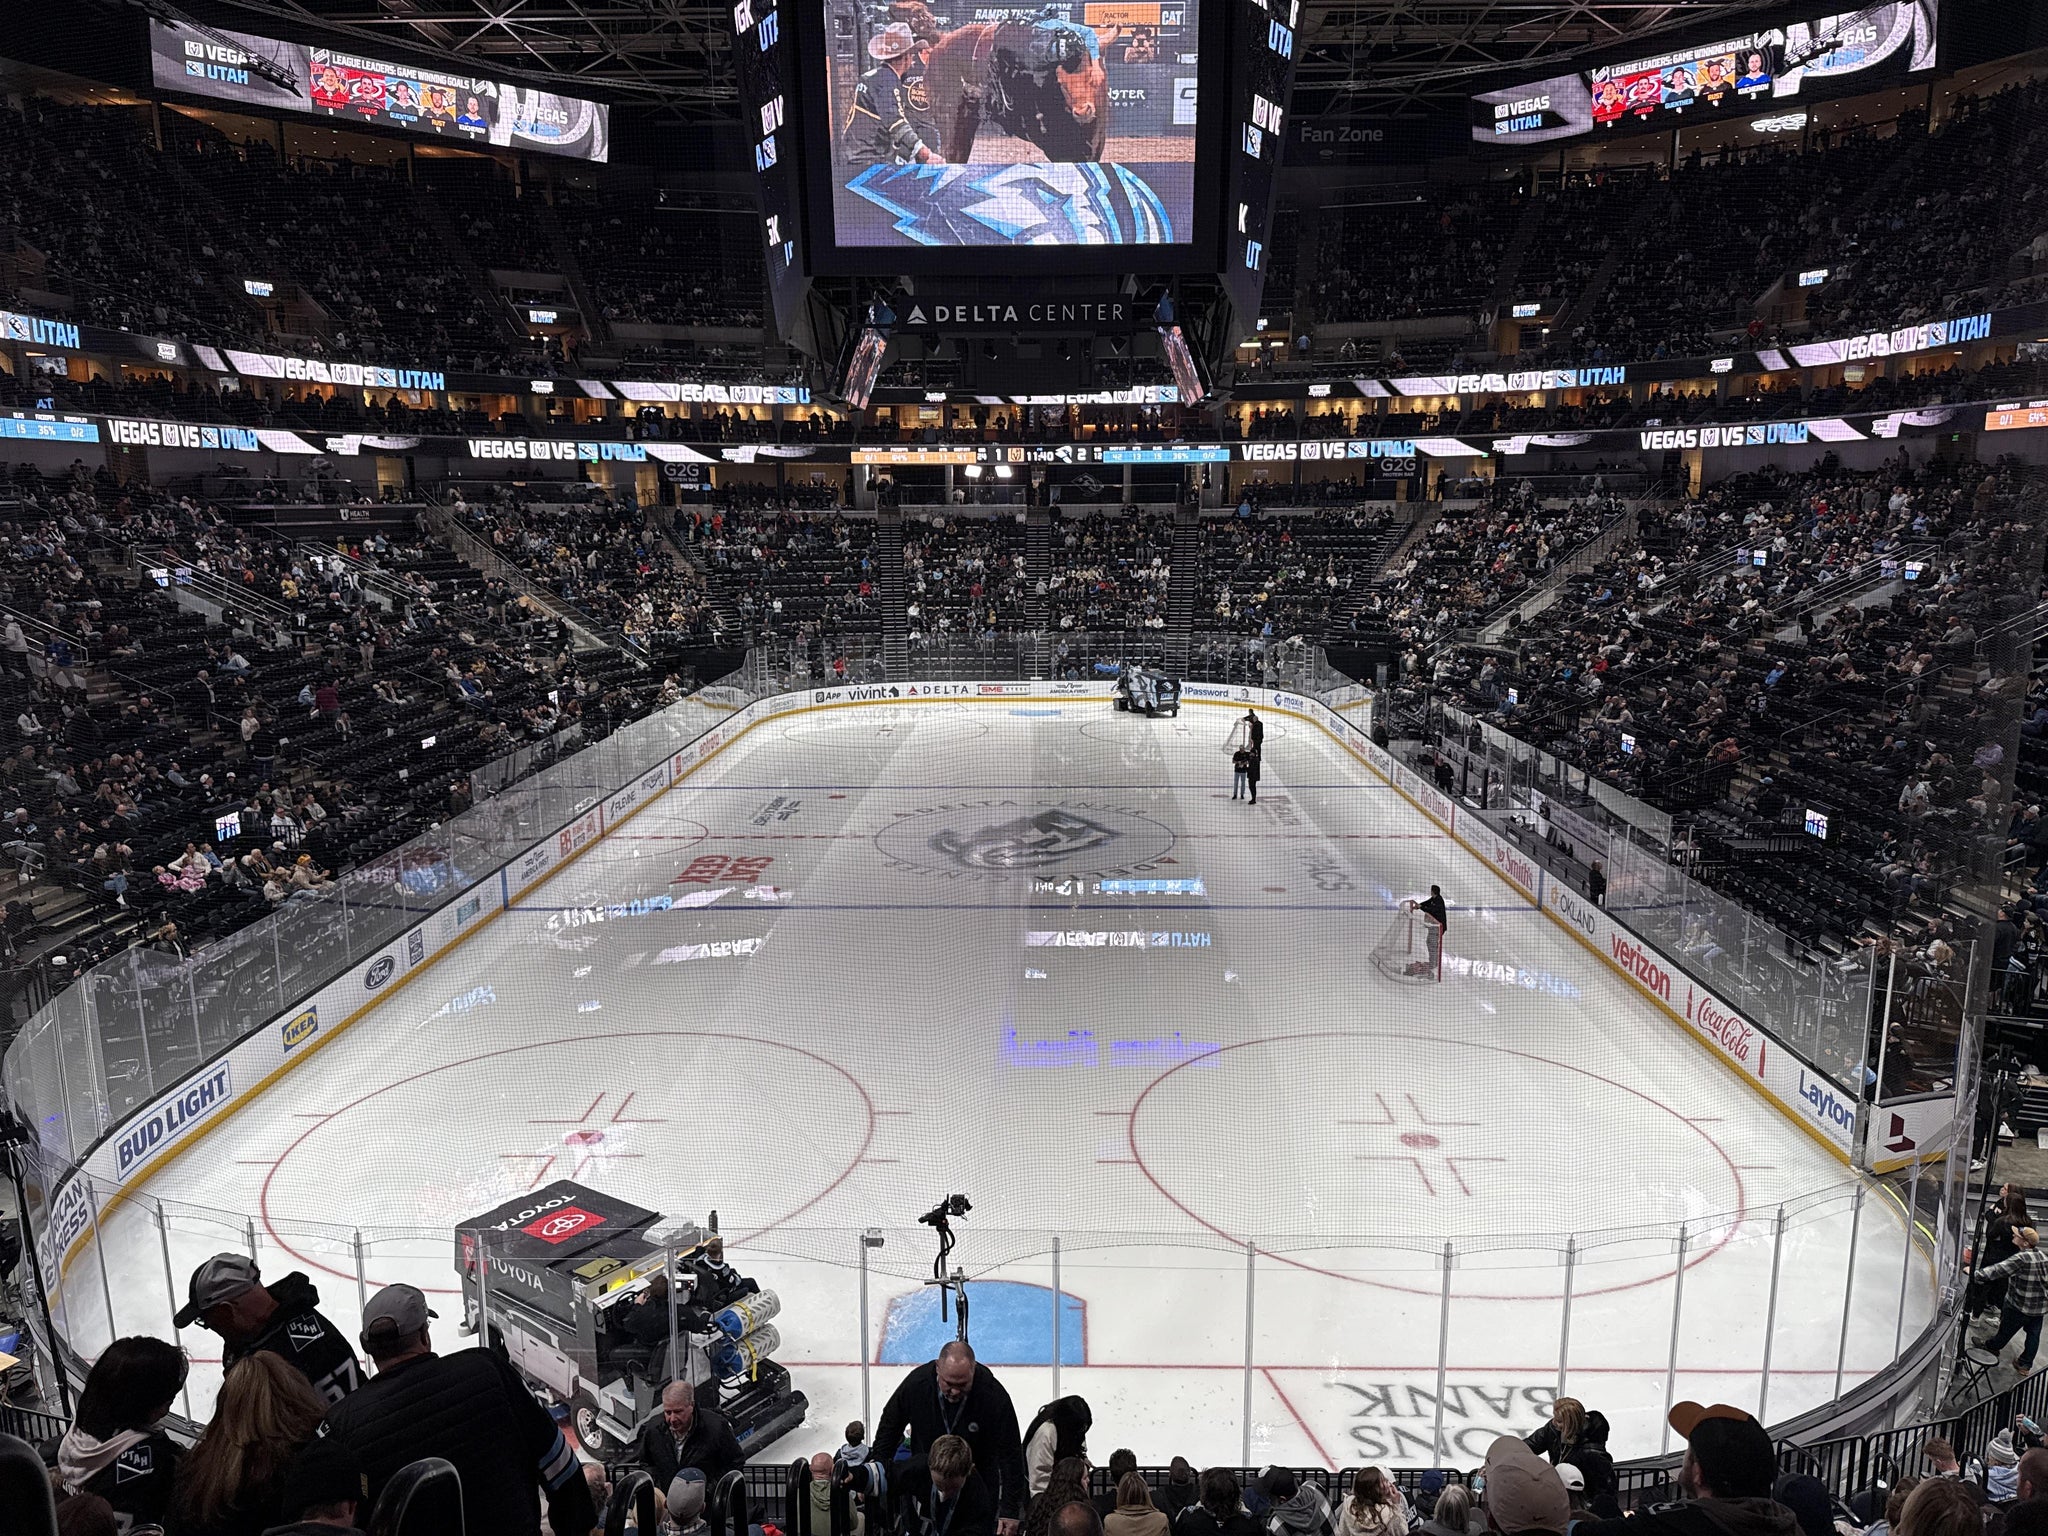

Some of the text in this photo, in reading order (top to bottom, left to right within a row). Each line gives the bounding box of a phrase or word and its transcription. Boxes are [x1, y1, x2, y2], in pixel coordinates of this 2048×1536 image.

[975, 9, 1009, 20] RAMPS
[1161, 10, 1184, 25] CAT
[1611, 63, 1639, 77] LEAGUE
[1639, 56, 1673, 72] LEADERS:
[1673, 50, 1694, 64] GAME
[1694, 43, 1726, 59] WINNING
[1726, 38, 1751, 51] GOALS
[207, 64, 249, 85] UTAH
[332, 53, 470, 90] LEAGUE LEADERS: GAME WINNING GOALS
[1510, 96, 1550, 116] VEGAS
[1510, 114, 1542, 132] UTAH
[1301, 127, 1384, 143] Fan Zone
[935, 304, 1124, 322] DELTA CENTER
[32, 317, 81, 349] UTAH
[1839, 313, 1992, 361] VEGAS VS UTAH
[274, 356, 445, 390] VEGAS VS UTAH
[1447, 366, 1625, 394] VEGAS VS UTAH
[671, 382, 774, 404] VEGAS VS
[1136, 386, 1157, 403] VS
[108, 419, 258, 451] VEGAS VS UTAH
[1640, 422, 1808, 450] VEGAS VS UTAH
[468, 440, 647, 462] VEGAS VS UTAH
[996, 449, 1002, 461] 1
[1026, 451, 1054, 461] 11:40
[1077, 448, 1087, 460] 2
[1242, 441, 1415, 461] VEGAS VS UTAH
[664, 463, 699, 477] G2G
[1381, 459, 1416, 472] G2G
[849, 686, 887, 700] vivint
[923, 685, 969, 694] DELTA
[1184, 686, 1229, 698] 1Password
[915, 800, 1017, 814] DELTA
[1420, 783, 1449, 822] Rio Tinto
[668, 855, 732, 884] GEEK
[718, 856, 774, 883] SEAT
[1034, 862, 1158, 882] DELTA
[1505, 847, 1534, 891] Smith's
[1560, 894, 1596, 935] OKLAND
[370, 961, 391, 986] Ford
[1611, 933, 1671, 1001] verizon
[286, 1015, 316, 1043] IKEA
[1798, 1069, 1855, 1135] Layton
[118, 1069, 227, 1170] BUD LIGHT
[490, 1195, 577, 1232] TOYOTA
[487, 1255, 544, 1293] TOYOTA
[289, 1322, 318, 1334] UTAH
[1334, 1382, 1558, 1419] BANK
